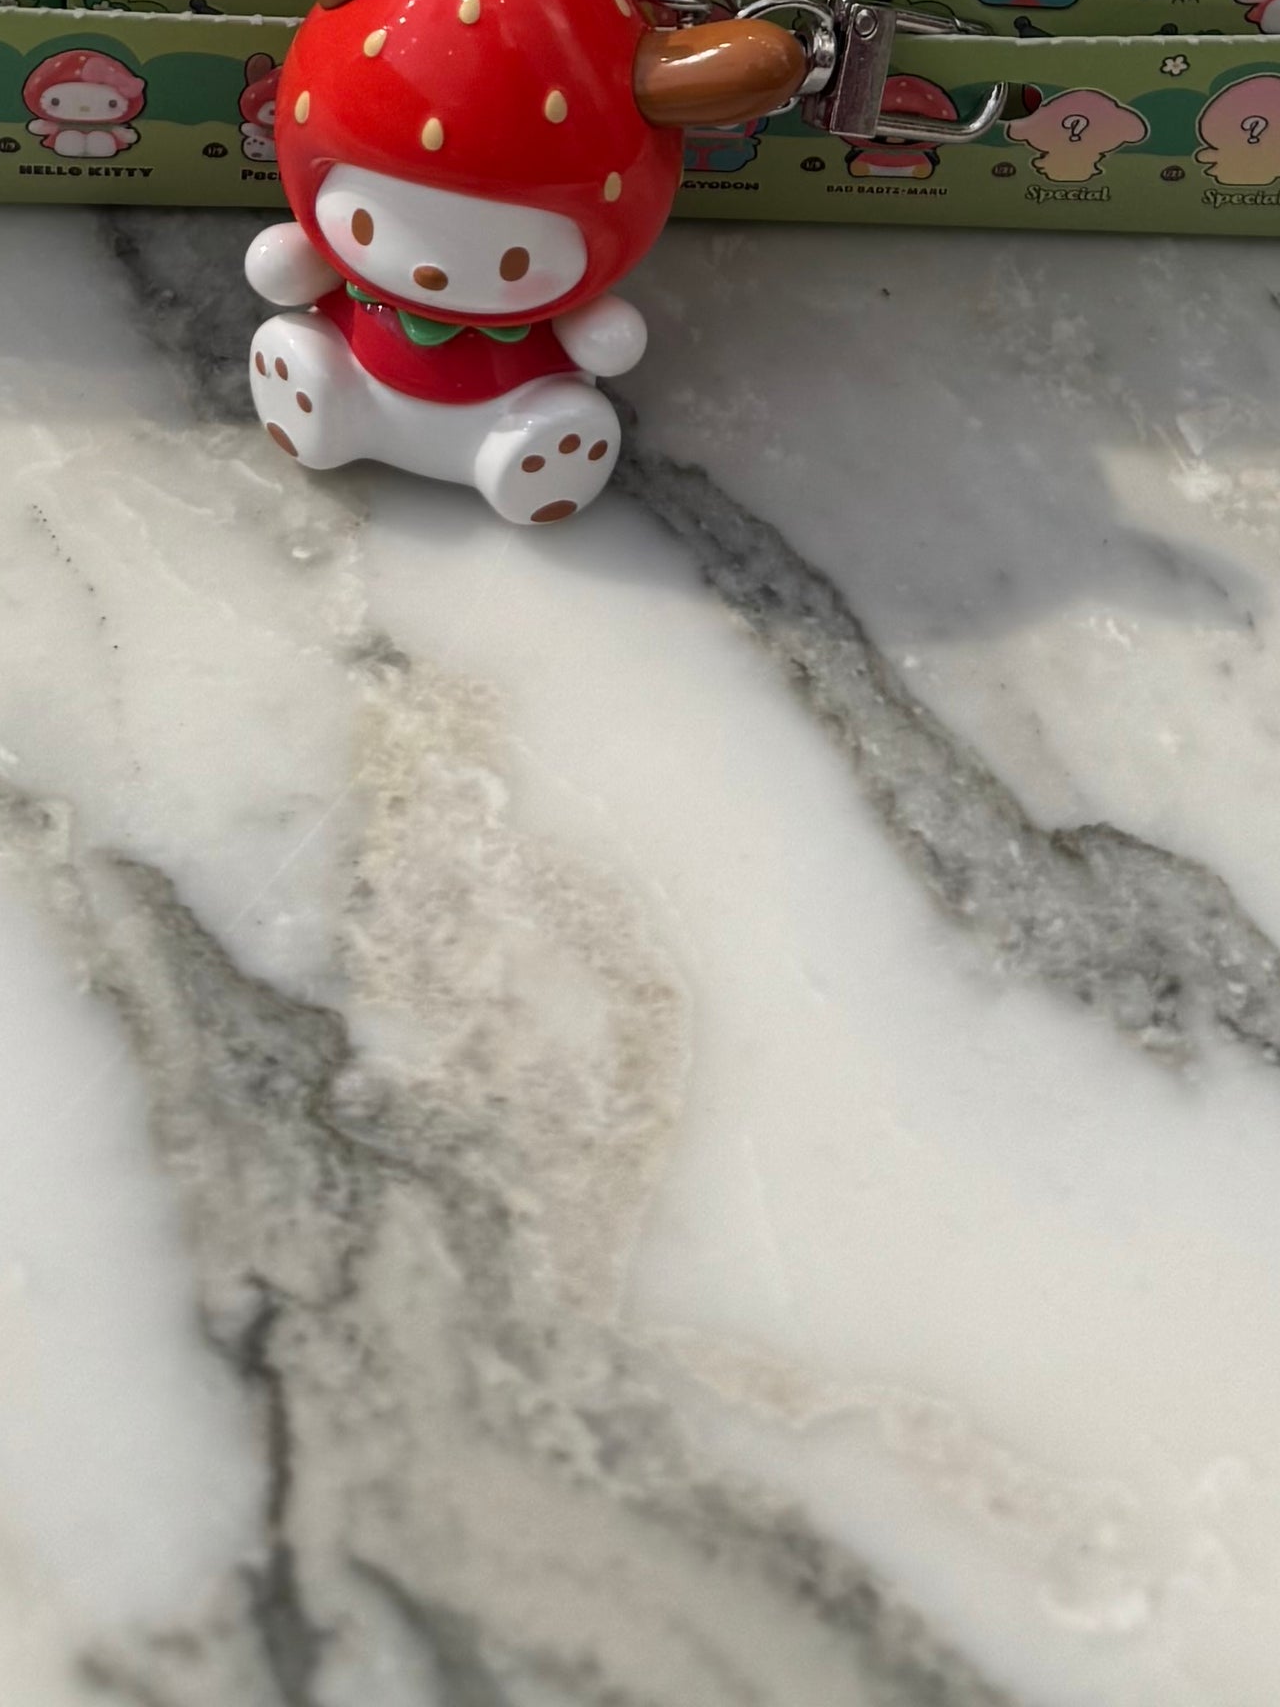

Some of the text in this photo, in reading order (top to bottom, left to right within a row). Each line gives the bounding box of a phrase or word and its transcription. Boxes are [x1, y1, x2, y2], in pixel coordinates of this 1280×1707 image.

[19, 164, 154, 178] HELLO KITTY
[681, 179, 759, 191] GYODON
[1025, 186, 1111, 204] Special
